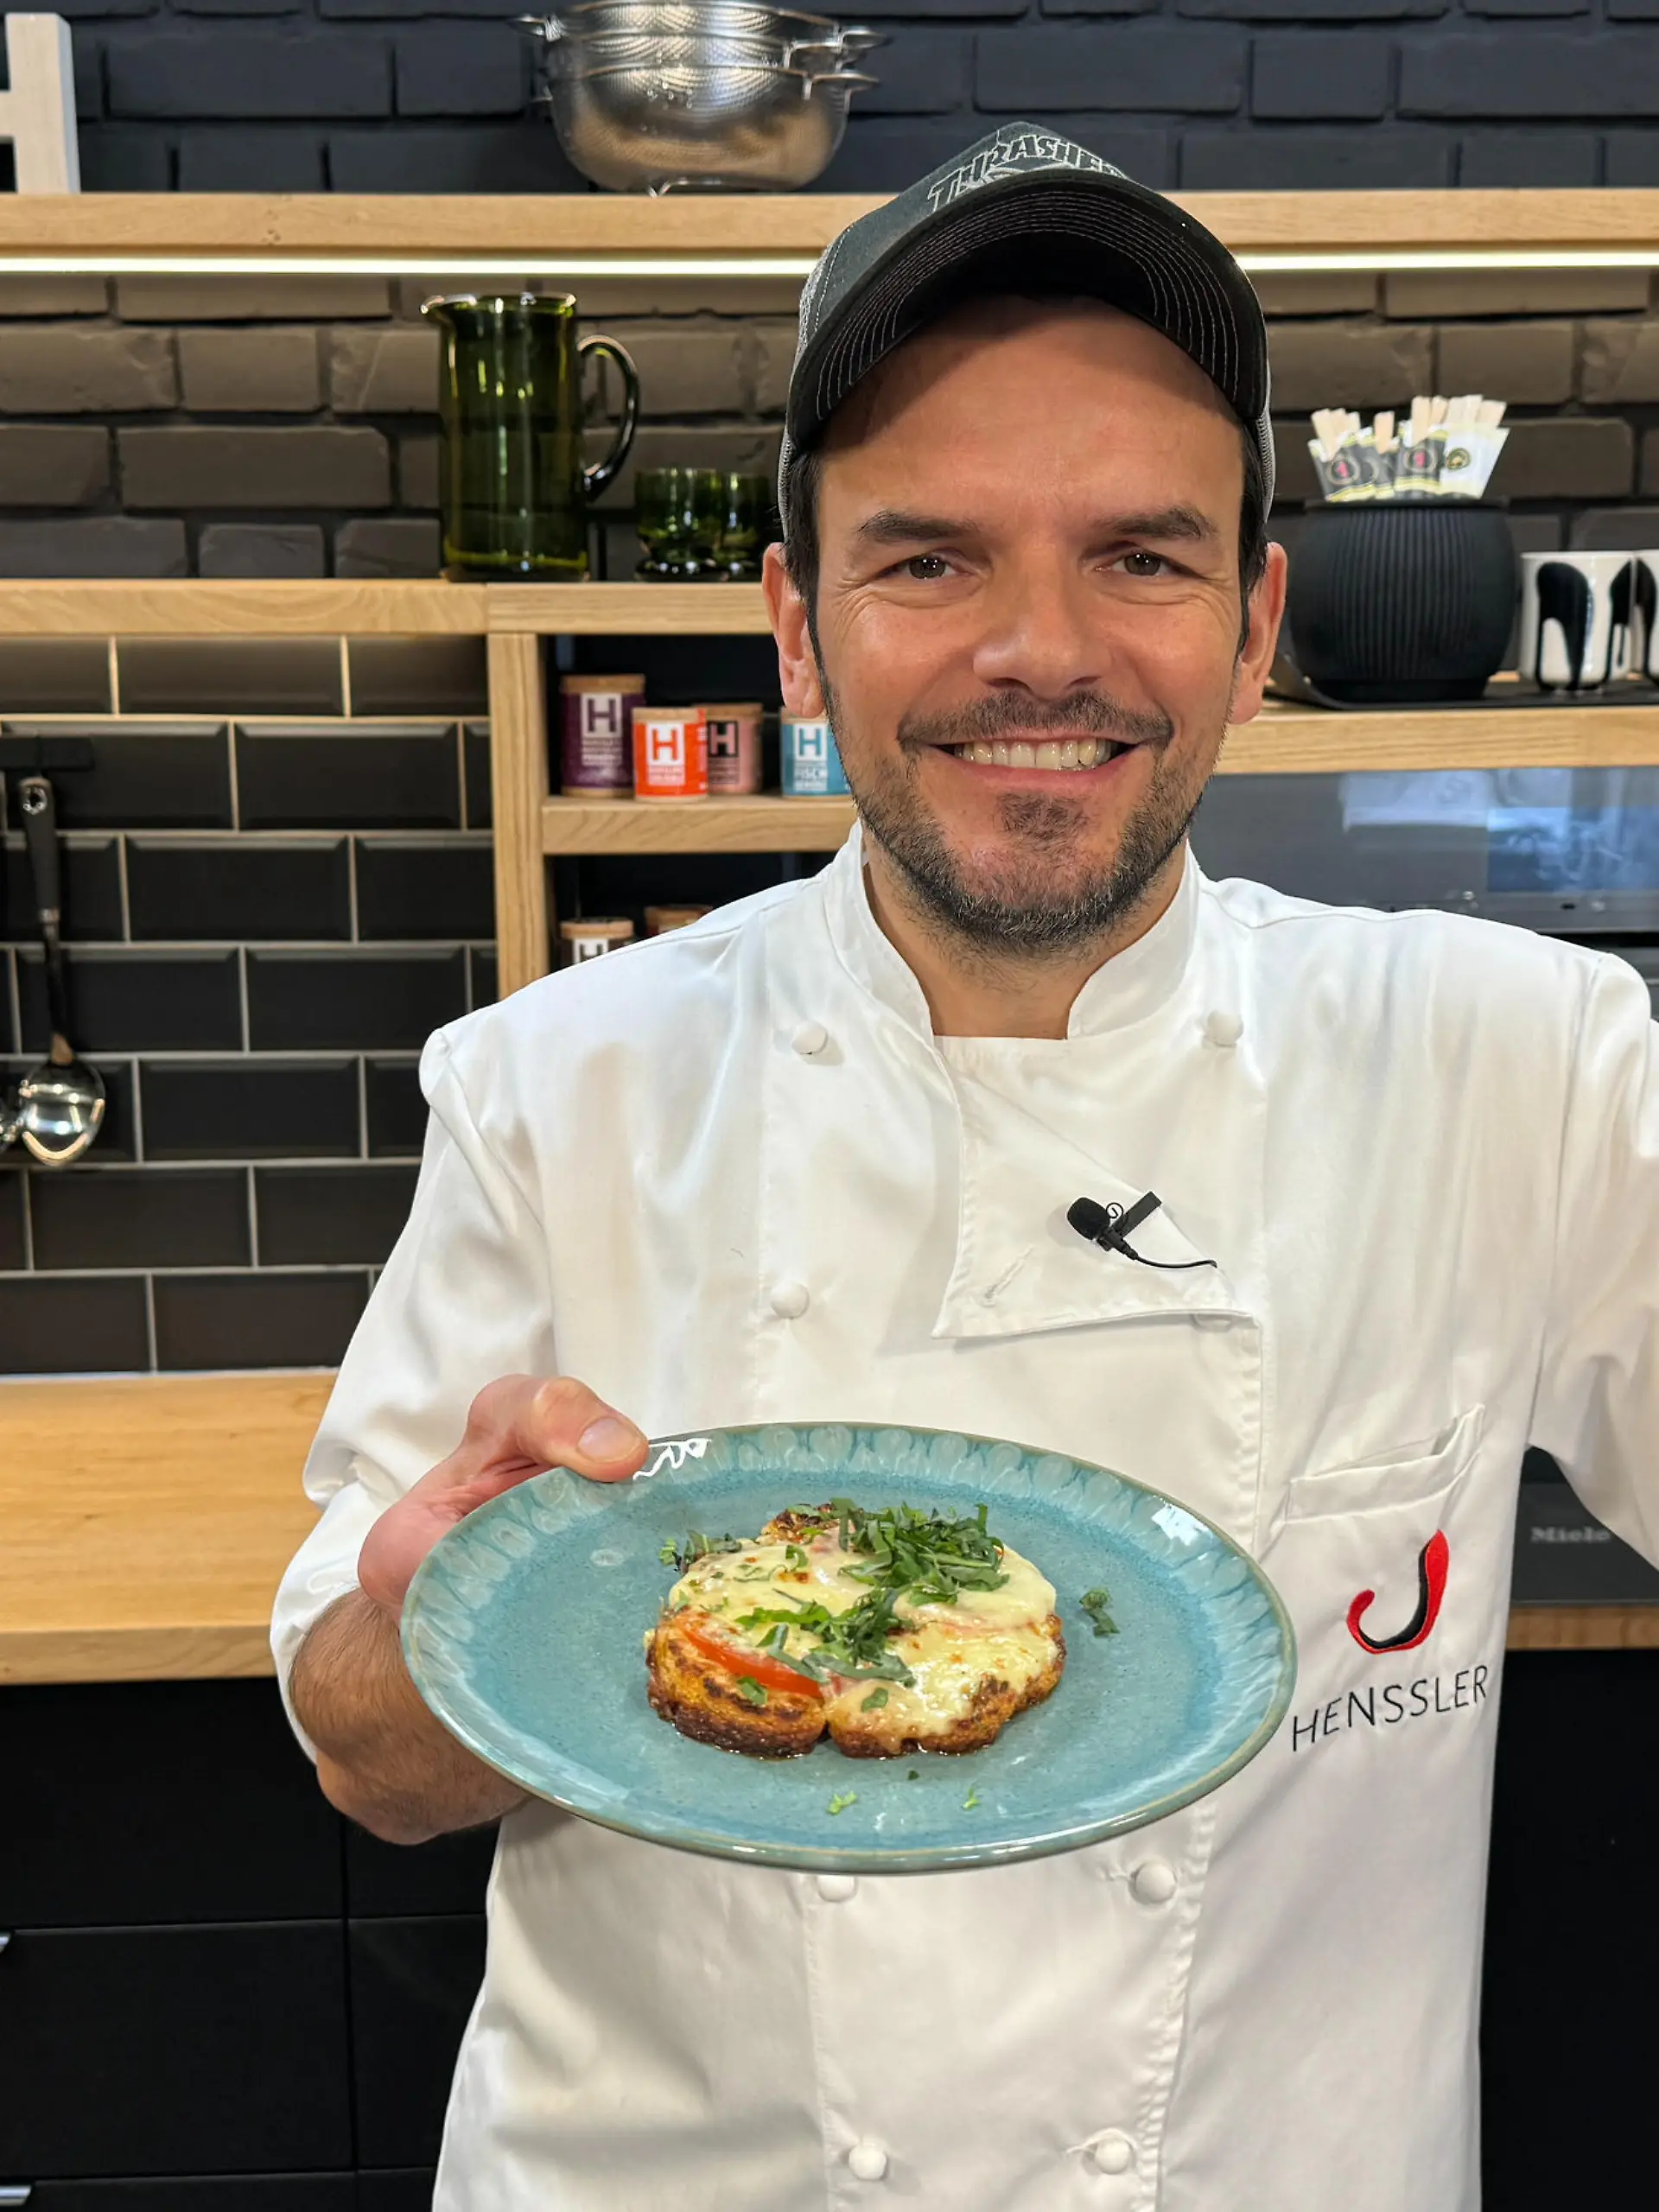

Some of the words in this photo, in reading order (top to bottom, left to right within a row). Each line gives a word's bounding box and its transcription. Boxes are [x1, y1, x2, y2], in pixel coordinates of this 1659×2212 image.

[587, 697, 618, 734] H
[652, 728, 678, 761] H
[710, 722, 735, 755] H
[799, 728, 822, 757] H
[1530, 1526, 1611, 1544] Miele
[1292, 1664, 1489, 1752] HENSSLER
